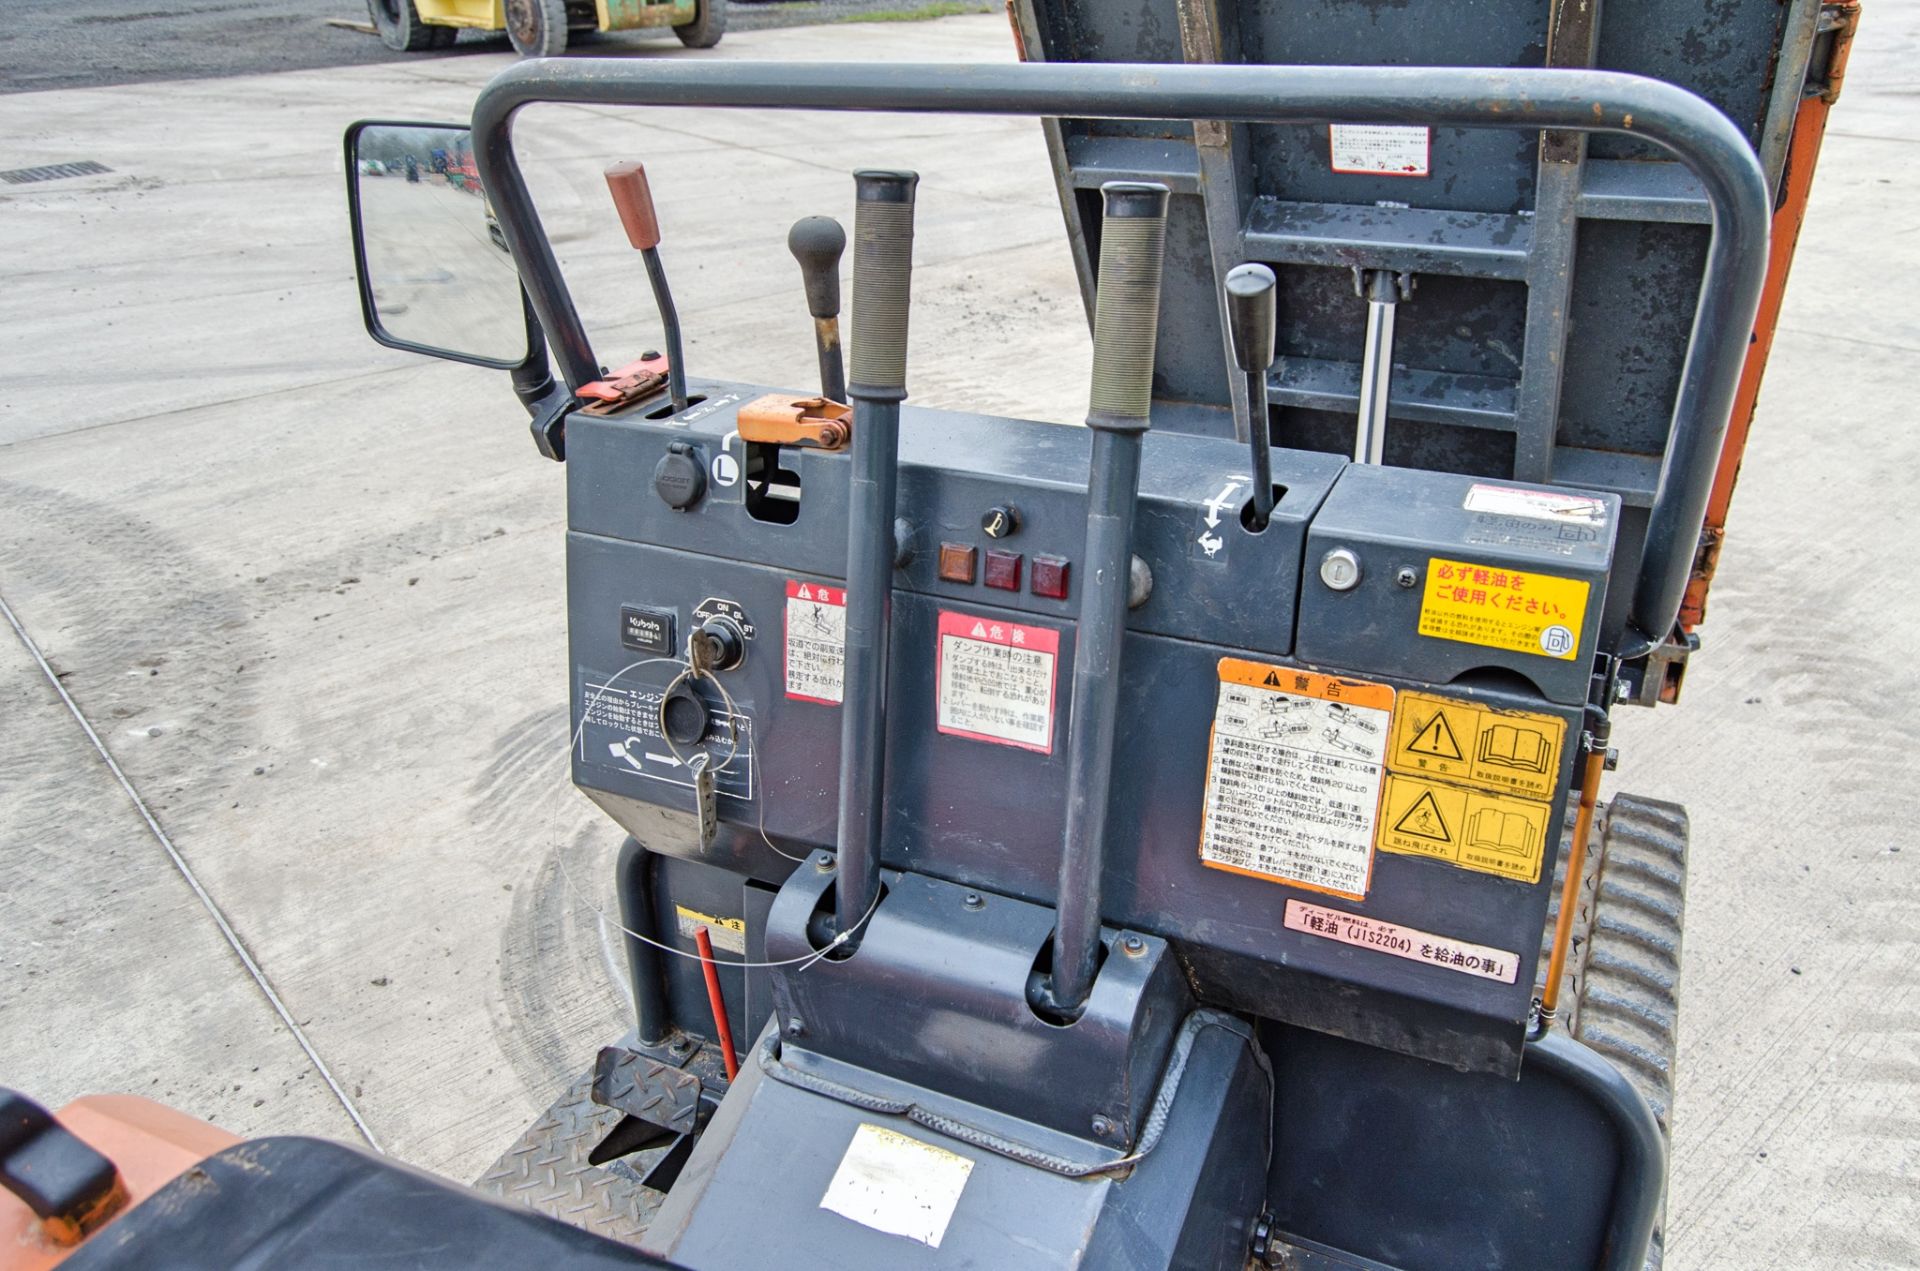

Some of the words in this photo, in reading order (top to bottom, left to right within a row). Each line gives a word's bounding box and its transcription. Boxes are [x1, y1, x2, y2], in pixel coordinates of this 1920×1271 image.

[717, 458, 734, 482] L
[1437, 564, 1526, 592] 必ず軽油を
[717, 603, 729, 612] ON
[1436, 585, 1567, 620] ご使用ください。
[630, 616, 660, 631] Kubota
[733, 611, 744, 620] GL
[743, 625, 754, 633] ST
[990, 624, 1025, 644] 危険
[952, 639, 1042, 666] ダンプ作業時の注意
[1294, 675, 1342, 697] 警告
[1393, 836, 1448, 855] 跳ね飛ばされ
